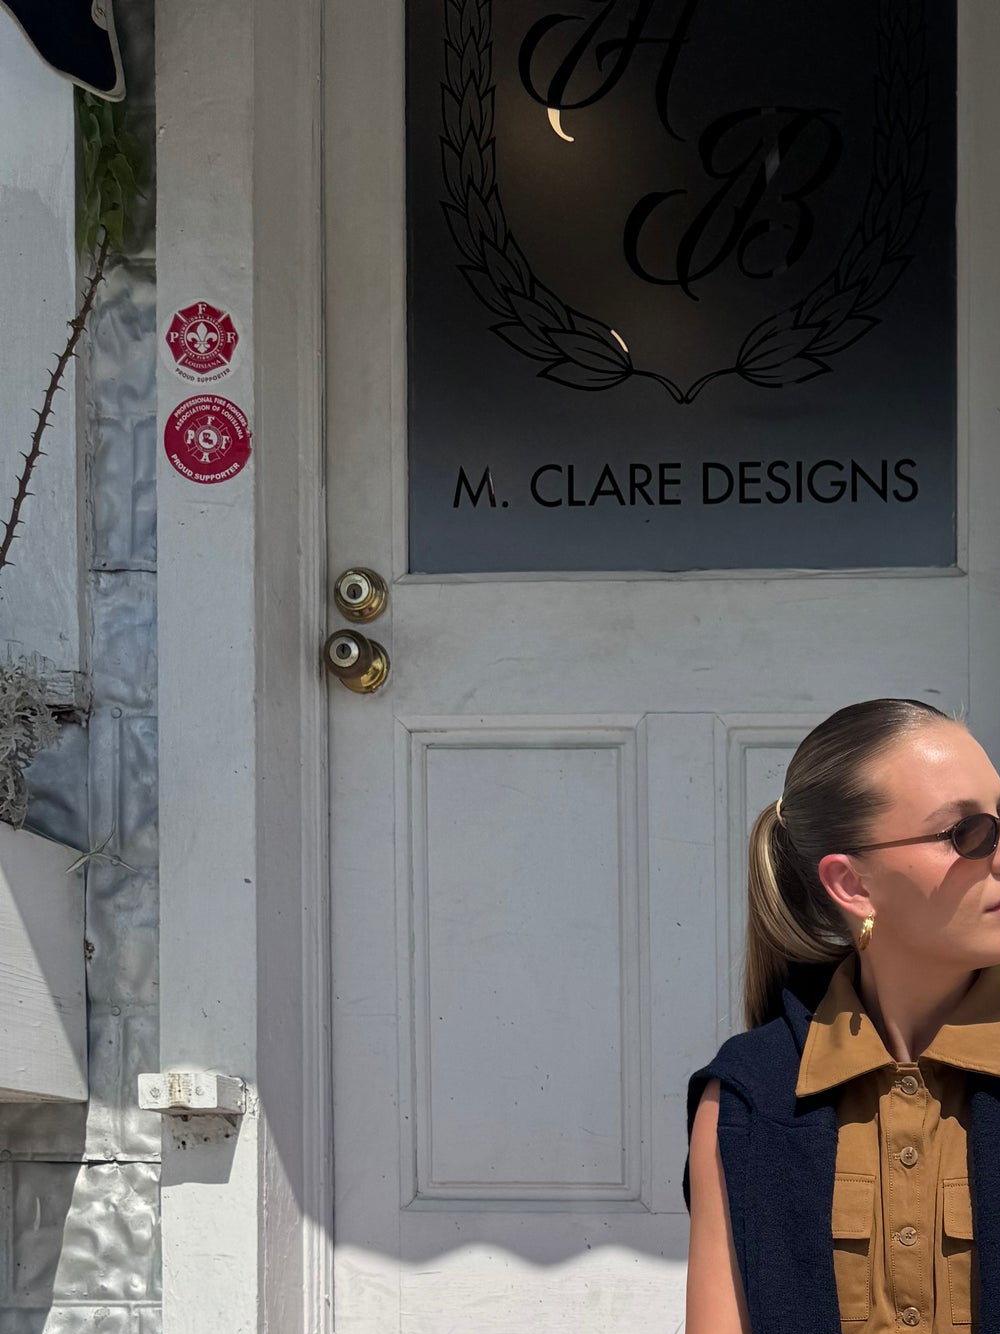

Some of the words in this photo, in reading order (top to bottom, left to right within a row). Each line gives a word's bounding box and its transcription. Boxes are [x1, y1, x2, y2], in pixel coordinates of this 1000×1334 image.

[175, 368, 195, 381] PROUD
[196, 368, 231, 383] SUPPORTER
[174, 397, 213, 418] PROFESSIONAL
[214, 397, 227, 407] FIRE
[226, 403, 248, 427] FIGHTERS
[175, 405, 211, 431] ASSOCIATION
[221, 409, 244, 440] LOUISIANA
[171, 453, 194, 477] PROUD
[194, 462, 240, 481] SUPPORTER
[452, 465, 509, 509] M.
[529, 461, 683, 508] CLARE
[701, 458, 920, 505] DESIGNS
